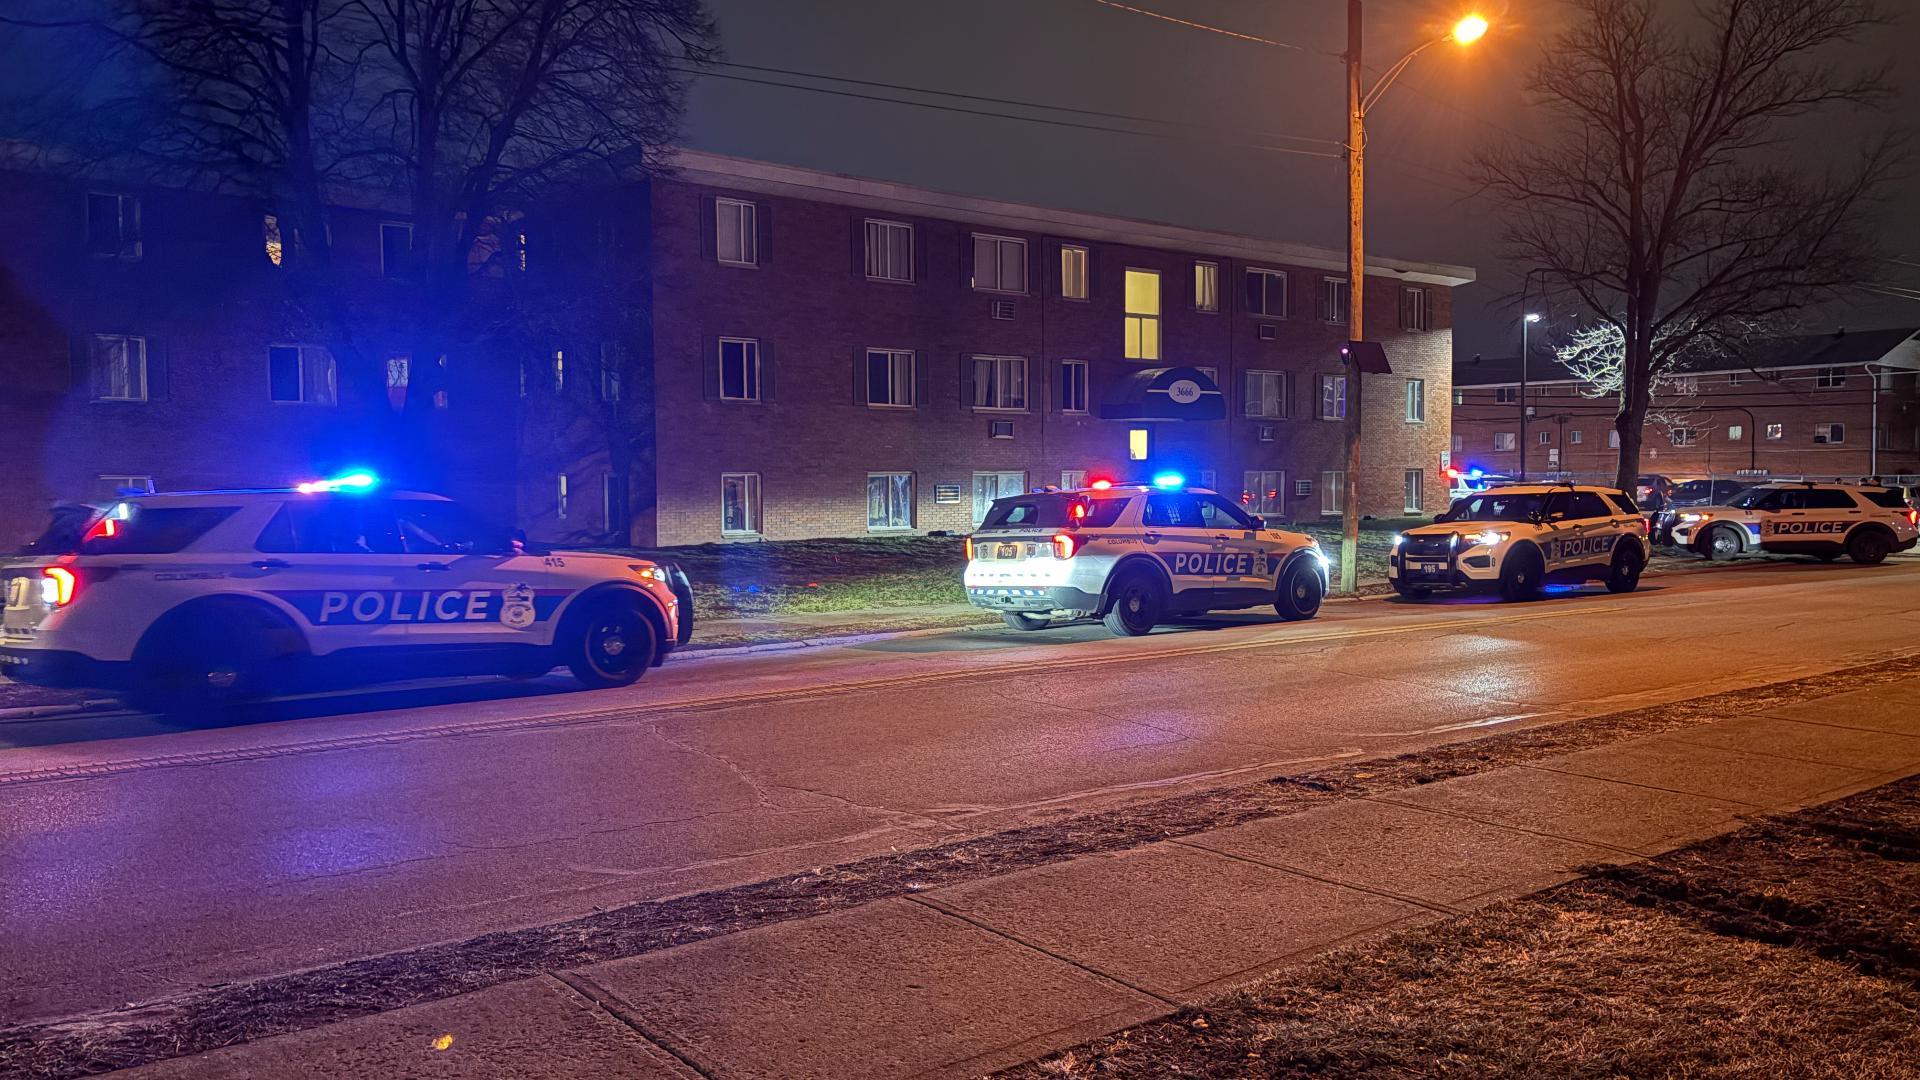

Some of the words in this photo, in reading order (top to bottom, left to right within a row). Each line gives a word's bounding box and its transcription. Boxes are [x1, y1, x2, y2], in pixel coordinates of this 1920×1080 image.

[1176, 386, 1194, 396] 3666
[1778, 521, 1843, 534] POLICE
[1001, 547, 1013, 557] 105
[1563, 536, 1609, 556] POLICE
[544, 557, 565, 567] 415
[1175, 553, 1248, 574] POLICE
[319, 591, 492, 623] POLICE
